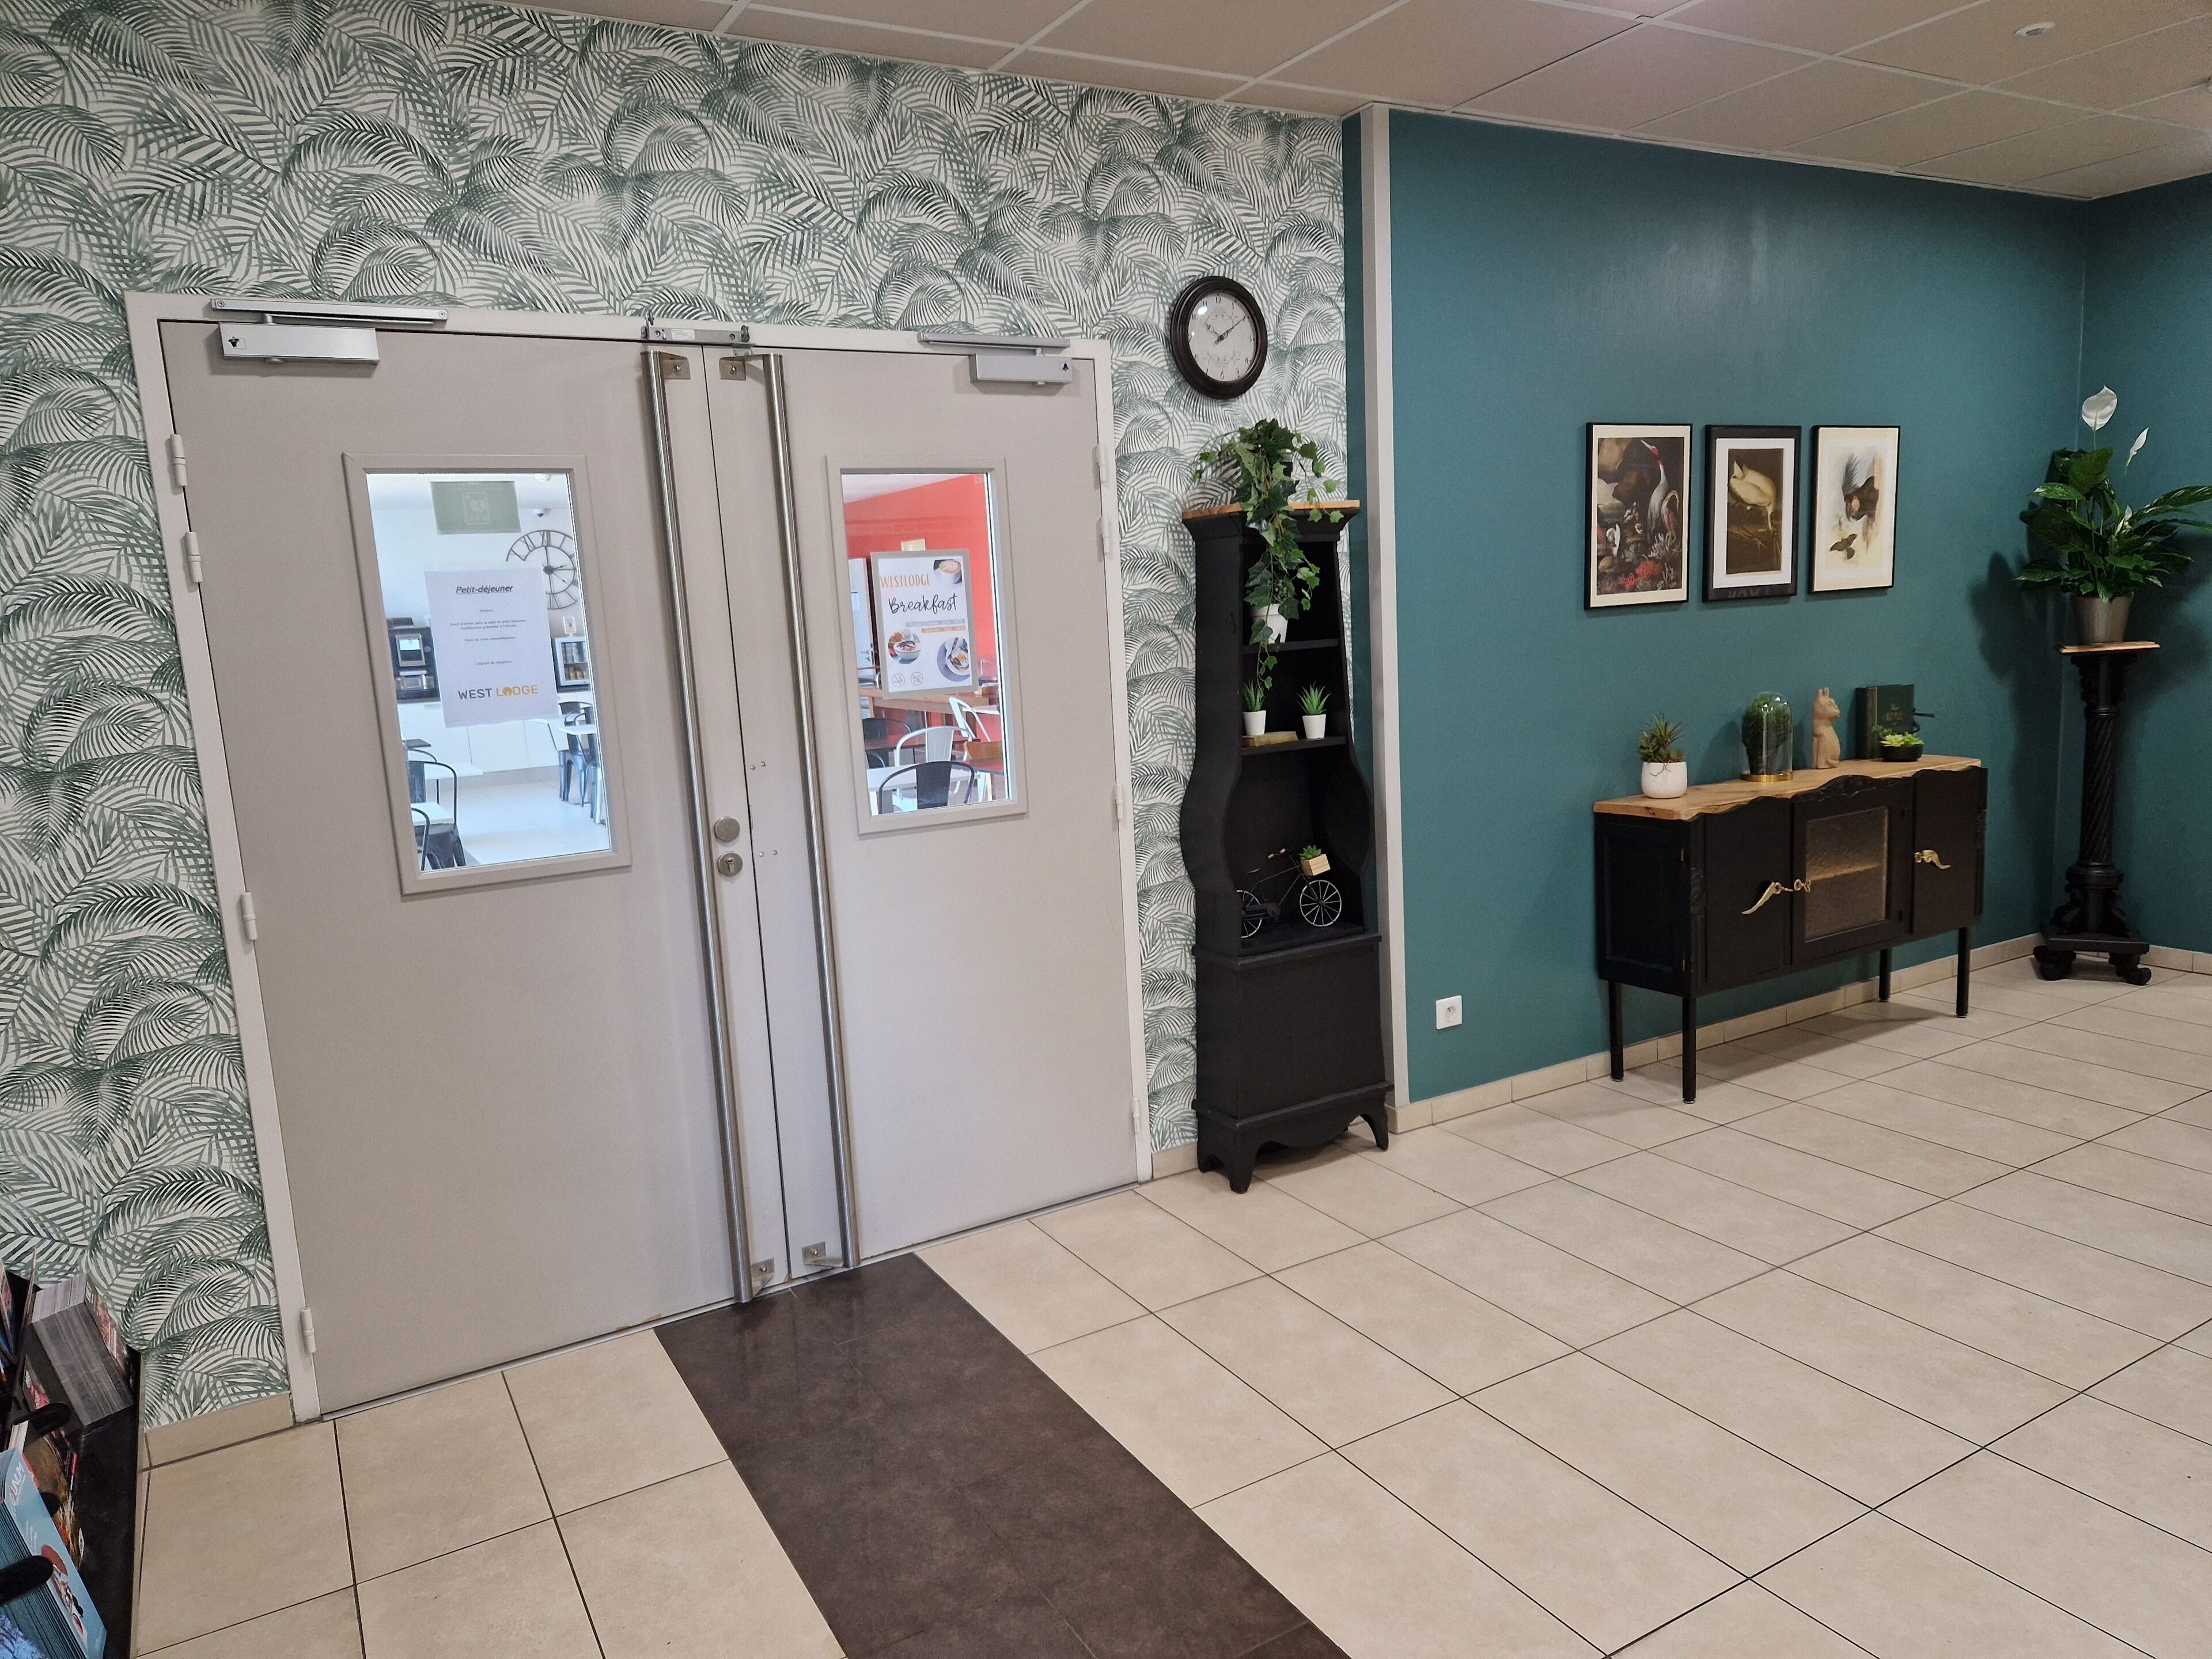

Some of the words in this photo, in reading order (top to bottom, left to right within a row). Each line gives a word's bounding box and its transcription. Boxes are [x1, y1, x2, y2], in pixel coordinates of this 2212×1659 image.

[1220, 370, 1225, 380] 6
[880, 574, 931, 588] WESTLODGE
[456, 585, 514, 594] Petit-déjeuner
[888, 593, 958, 614] Breakfast
[458, 688, 493, 700] WEST
[496, 684, 539, 697] LODGE
